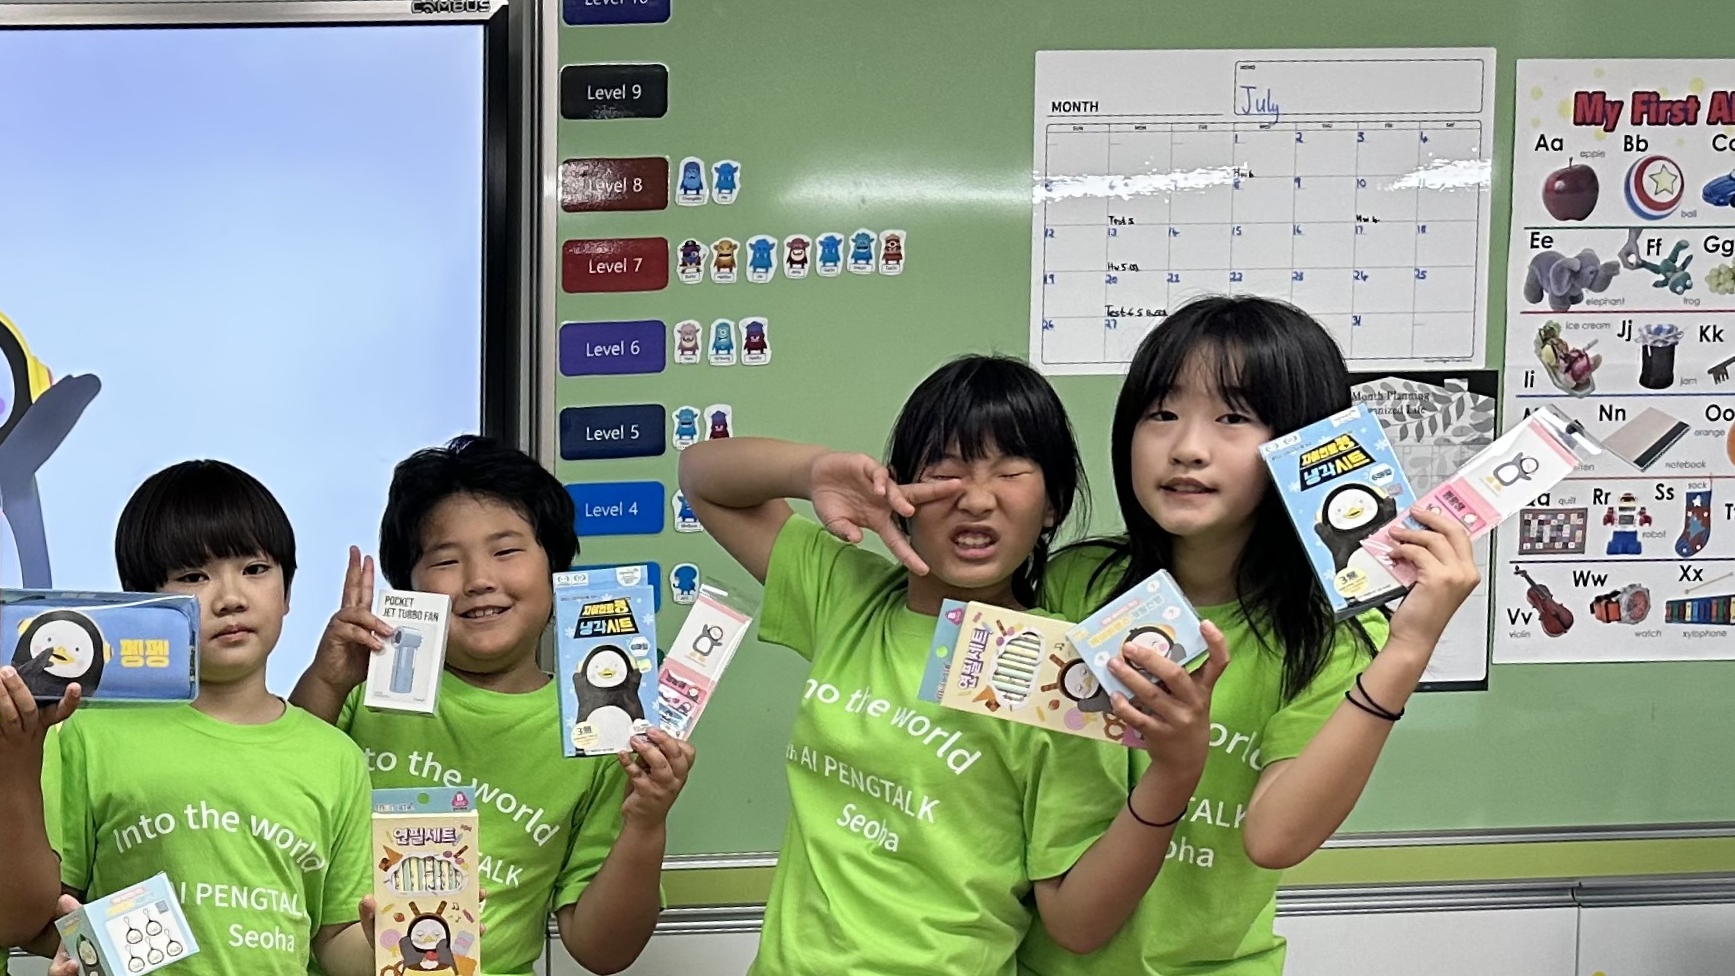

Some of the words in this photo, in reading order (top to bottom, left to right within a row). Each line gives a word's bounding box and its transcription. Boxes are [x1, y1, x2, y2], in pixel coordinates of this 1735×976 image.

[587, 84, 626, 100] Level
[632, 84, 642, 99] 9
[1051, 101, 1099, 113] MONTH
[1240, 85, 1280, 125] July
[1573, 91, 1624, 132] My
[1631, 91, 1700, 126] First
[1295, 132, 1303, 143] 2
[1357, 132, 1365, 142] 3
[1420, 132, 1428, 143] 4
[1535, 134, 1564, 151] Aa
[1623, 135, 1649, 152] Bb
[632, 178, 643, 193] 8
[1294, 177, 1301, 188] 9
[1356, 178, 1366, 188] 10
[1044, 228, 1055, 238] 12
[1108, 228, 1117, 236] 13
[1168, 227, 1180, 237] 14
[1231, 226, 1242, 236] 15
[1293, 225, 1302, 235] 16
[1354, 225, 1364, 235] 17
[1417, 225, 1426, 234] 18
[1530, 232, 1554, 249] Ee
[1646, 238, 1662, 256] Ff
[1703, 235, 1735, 258] Gg
[589, 258, 627, 274] Level
[633, 258, 643, 272] 7
[1044, 274, 1055, 284] 19
[1105, 274, 1118, 284] 20
[1167, 273, 1180, 282] 21
[1230, 272, 1243, 282] 22
[1292, 271, 1303, 281] 23
[1353, 270, 1368, 281] 24
[1414, 268, 1427, 279] 25
[1585, 296, 1625, 306] elephant
[1683, 296, 1701, 306] frog
[1042, 320, 1054, 329] 26
[1104, 319, 1117, 329] 27
[1565, 321, 1579, 330] ice
[1581, 322, 1611, 330] cream
[1617, 319, 1633, 342] Jj
[1699, 325, 1724, 342] Kk
[586, 342, 625, 358] Level
[630, 341, 641, 355] 6
[1679, 377, 1698, 387] jam
[1352, 390, 1384, 401] Month
[1387, 389, 1430, 402] Planning
[1406, 404, 1426, 415] Life
[1599, 404, 1626, 421] Nn
[1705, 404, 1735, 421] Oo
[586, 426, 625, 442] Level
[630, 425, 640, 440] 5
[1693, 429, 1725, 438] orange
[1304, 452, 1370, 486] 냉각시트
[1665, 460, 1706, 469] notebook
[1655, 483, 1674, 500] Ss
[1687, 481, 1707, 490] sock
[1593, 489, 1611, 505] Rr
[585, 502, 624, 517] Level
[628, 502, 638, 516] 4
[1642, 530, 1666, 538] robot
[1573, 570, 1608, 587] Ww
[1678, 565, 1703, 582] Xx
[385, 595, 414, 607] POCKET
[383, 608, 396, 617] JET
[398, 609, 423, 620] TURBO
[424, 612, 439, 622] FAN
[1507, 608, 1532, 625] Vv
[580, 617, 635, 636] 냉각시트
[1509, 630, 1531, 638] violin
[1635, 630, 1662, 638] watch
[1682, 630, 1727, 639] xylophone
[845, 687, 890, 717] the
[890, 706, 982, 775] world
[1209, 722, 1263, 770] orl
[800, 746, 817, 772] AI
[824, 755, 940, 824] PENGTALK
[366, 748, 397, 772] to
[408, 751, 462, 787] the
[469, 778, 560, 848] world
[836, 803, 899, 852] Seoha
[113, 812, 175, 854] Into
[184, 801, 239, 832] the
[250, 815, 326, 873] world
[393, 827, 458, 847] 연필세트
[1165, 836, 1214, 868] oha
[196, 882, 308, 917] PENGTAL
[228, 924, 295, 953] Seoha
